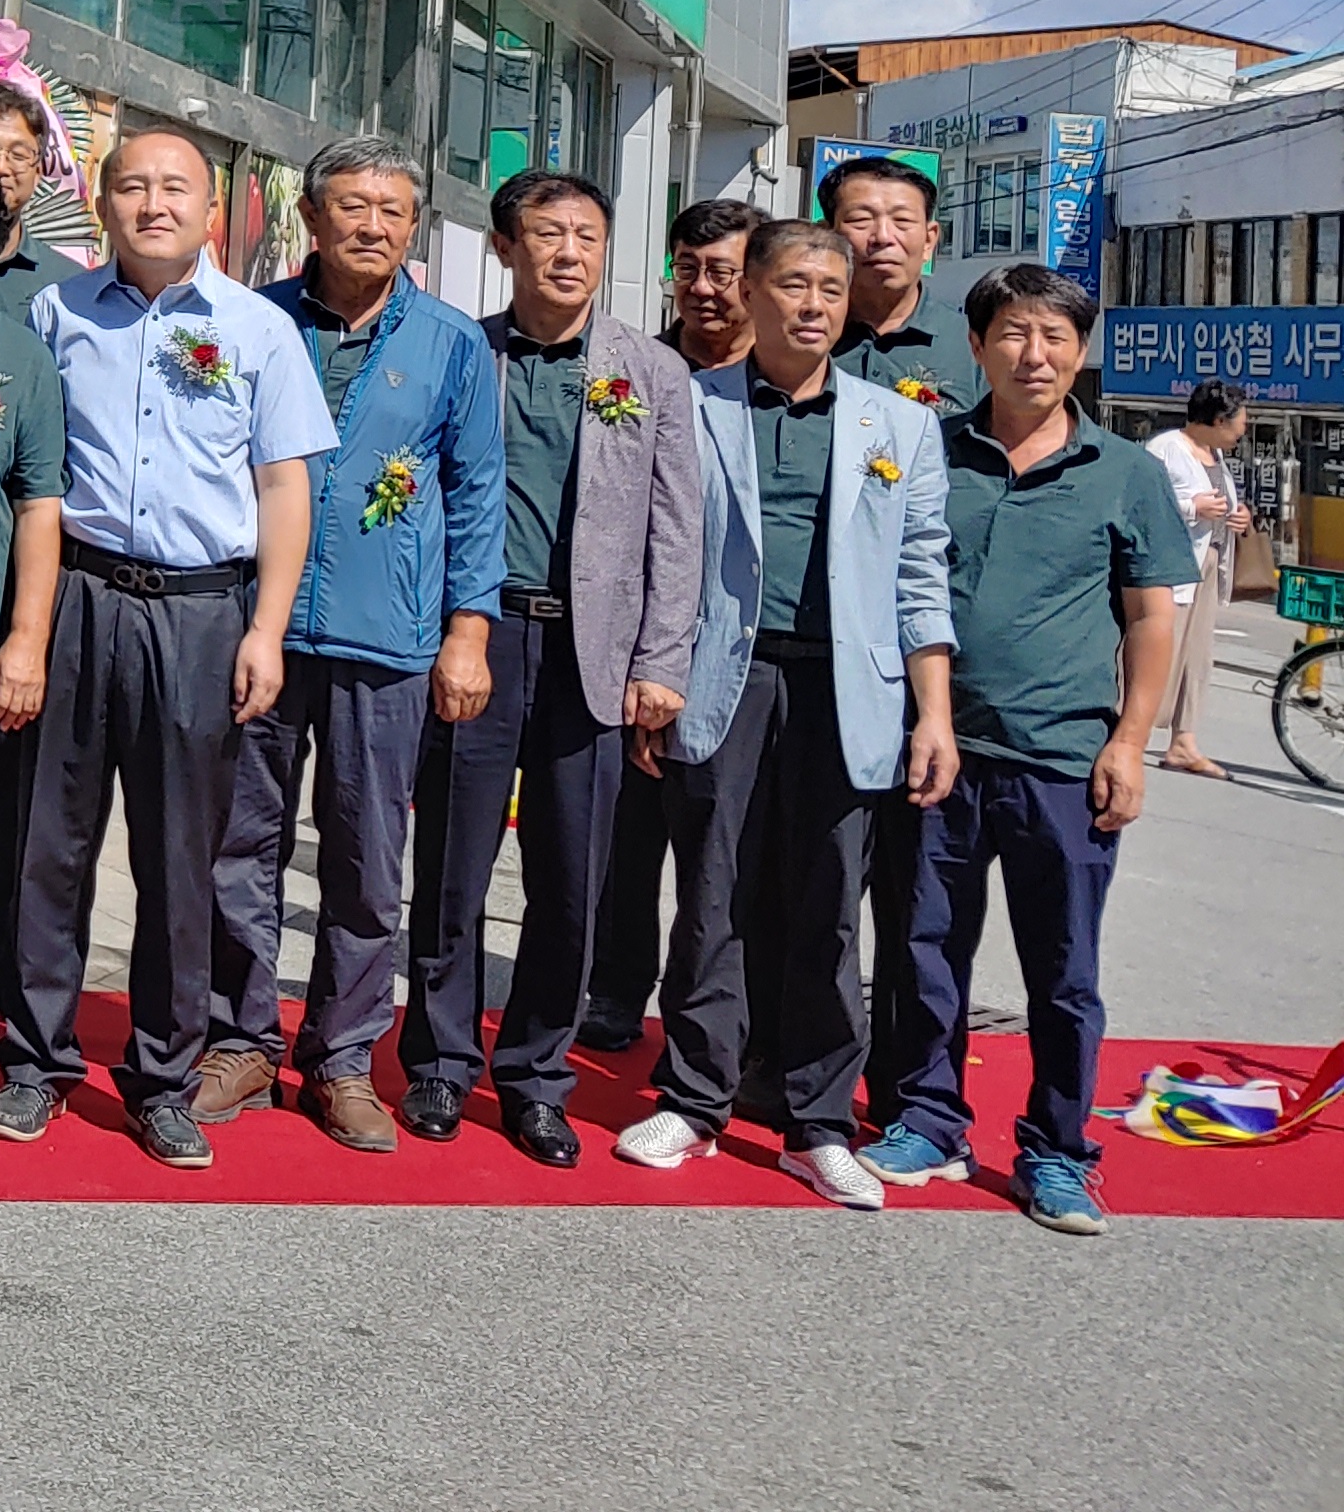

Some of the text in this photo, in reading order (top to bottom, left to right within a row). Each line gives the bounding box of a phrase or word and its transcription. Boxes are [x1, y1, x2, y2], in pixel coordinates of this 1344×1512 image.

[1114, 320, 1344, 379] 법무사 임성철 사무
